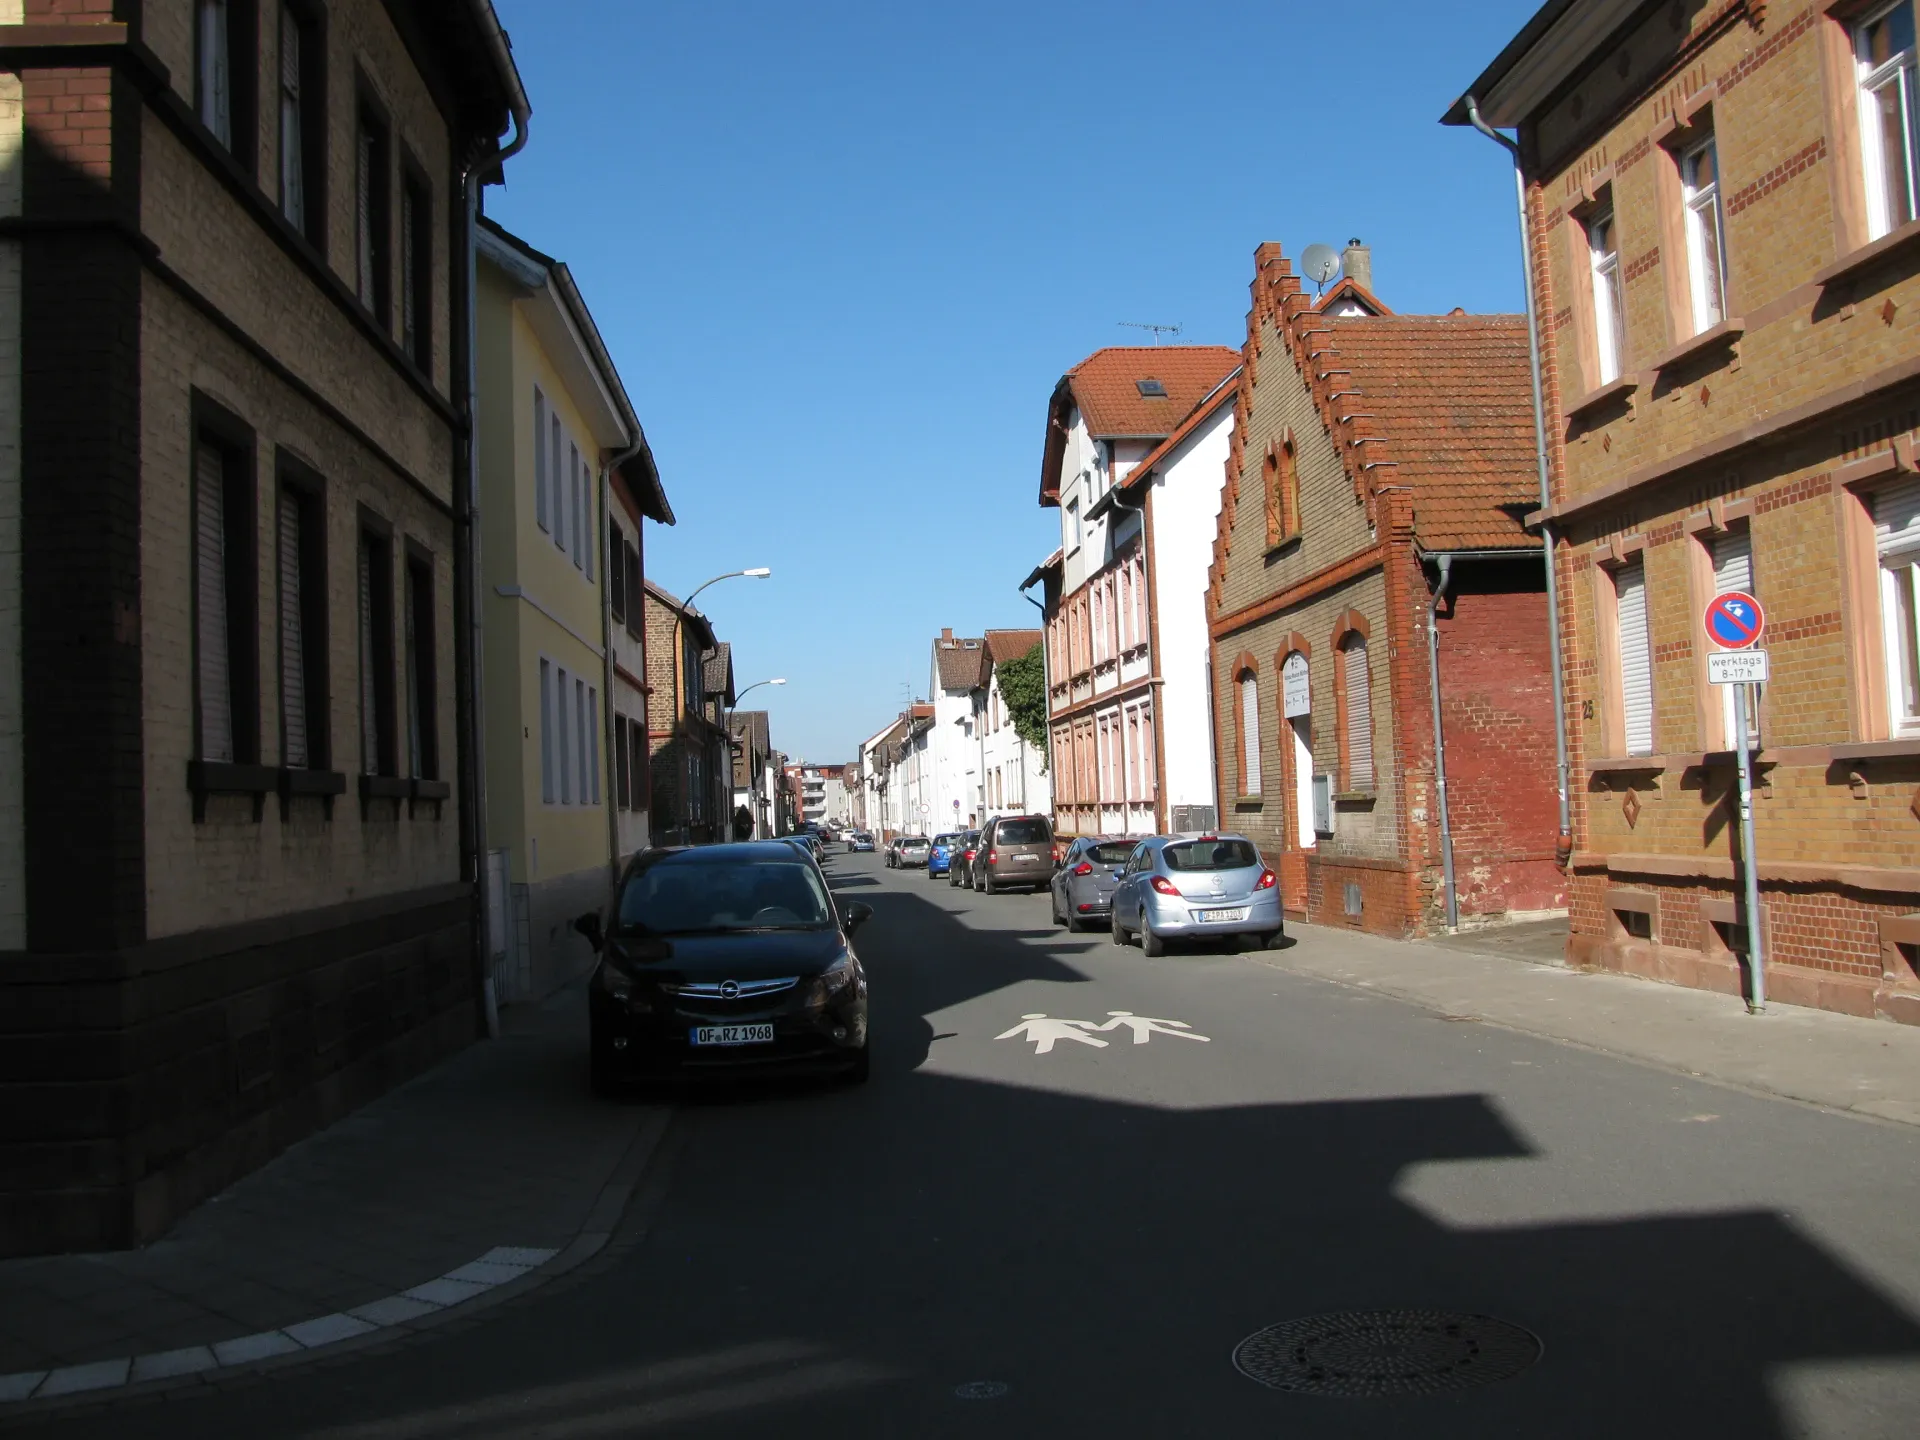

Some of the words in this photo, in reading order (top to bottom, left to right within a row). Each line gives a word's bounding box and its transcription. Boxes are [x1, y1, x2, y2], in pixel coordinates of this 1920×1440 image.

[1711, 656, 1762, 667] werktags
[1722, 668, 1744, 679] 8-17
[1747, 668, 1753, 678] h
[699, 1028, 715, 1043] OF
[722, 1027, 739, 1042] RZ
[741, 1026, 772, 1041] 1968
